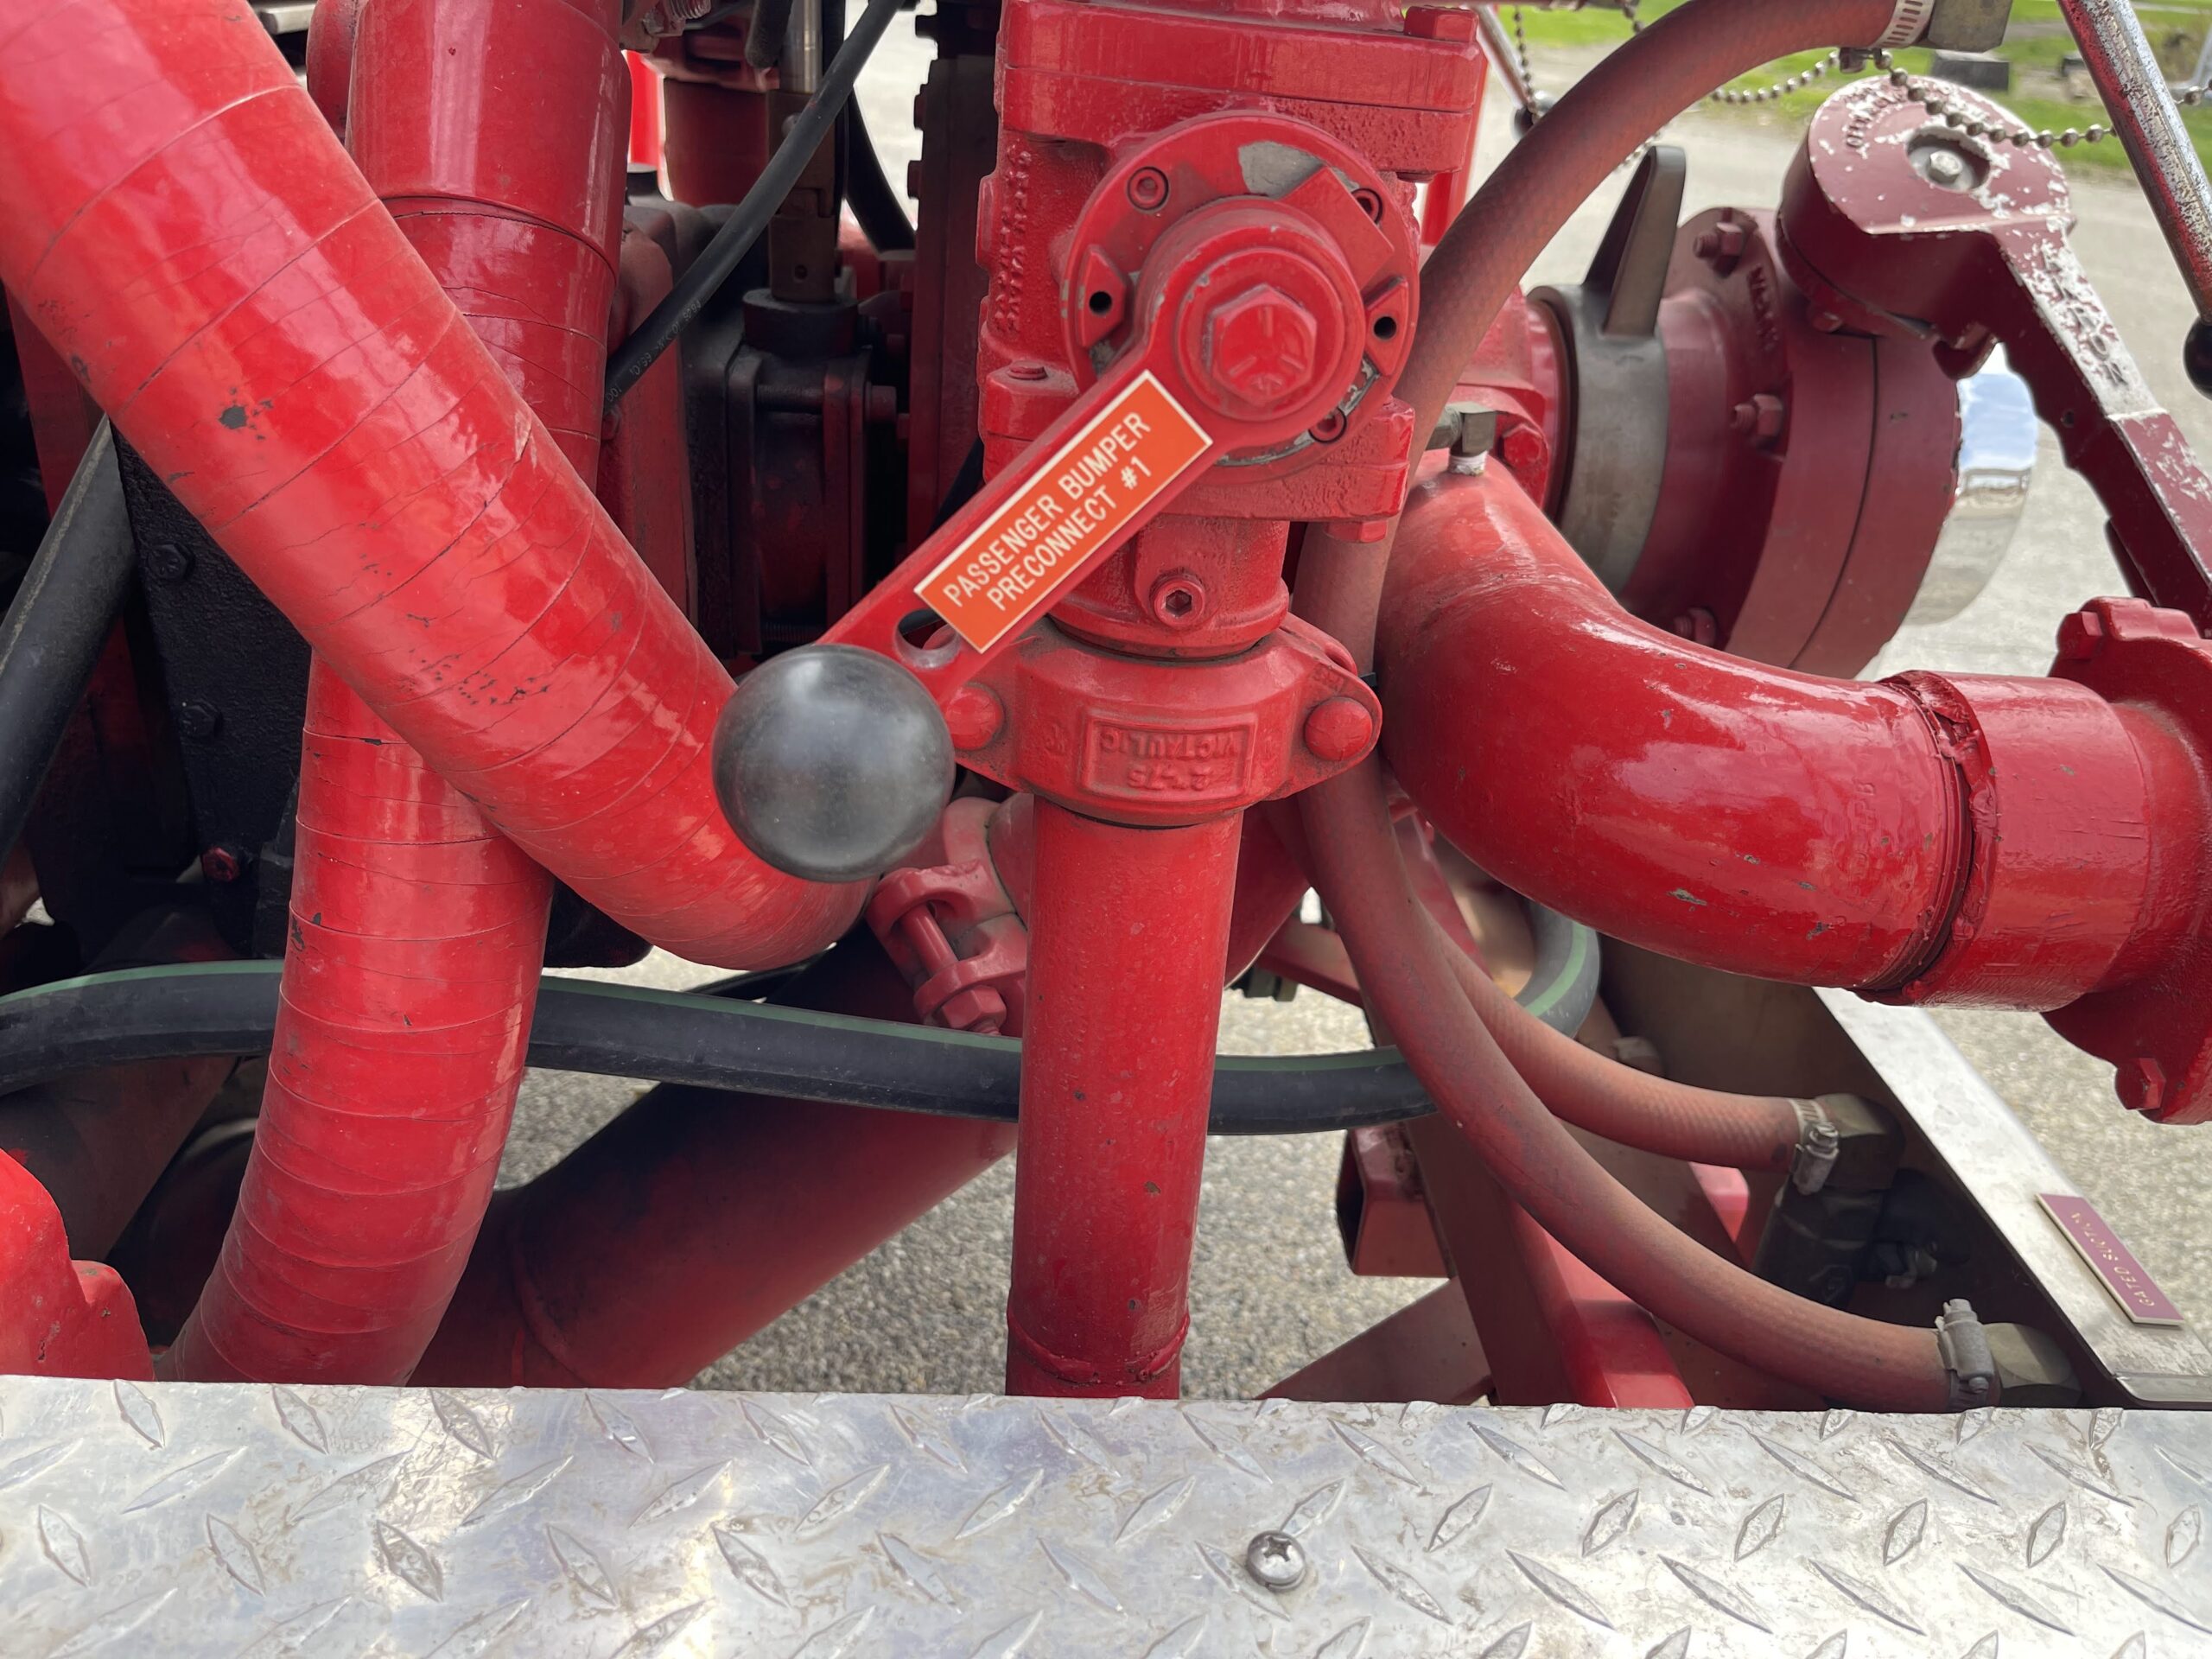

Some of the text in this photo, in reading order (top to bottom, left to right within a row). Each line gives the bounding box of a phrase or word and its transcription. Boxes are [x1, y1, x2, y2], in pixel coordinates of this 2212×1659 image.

[2040, 242, 2129, 387] AKRON
[943, 412, 1151, 607] PASSENGER BUMPER
[986, 454, 1153, 612] PRECONNECT #1
[1100, 728, 1238, 760] VICTAULIC
[2113, 1265, 2156, 1307] GATED
